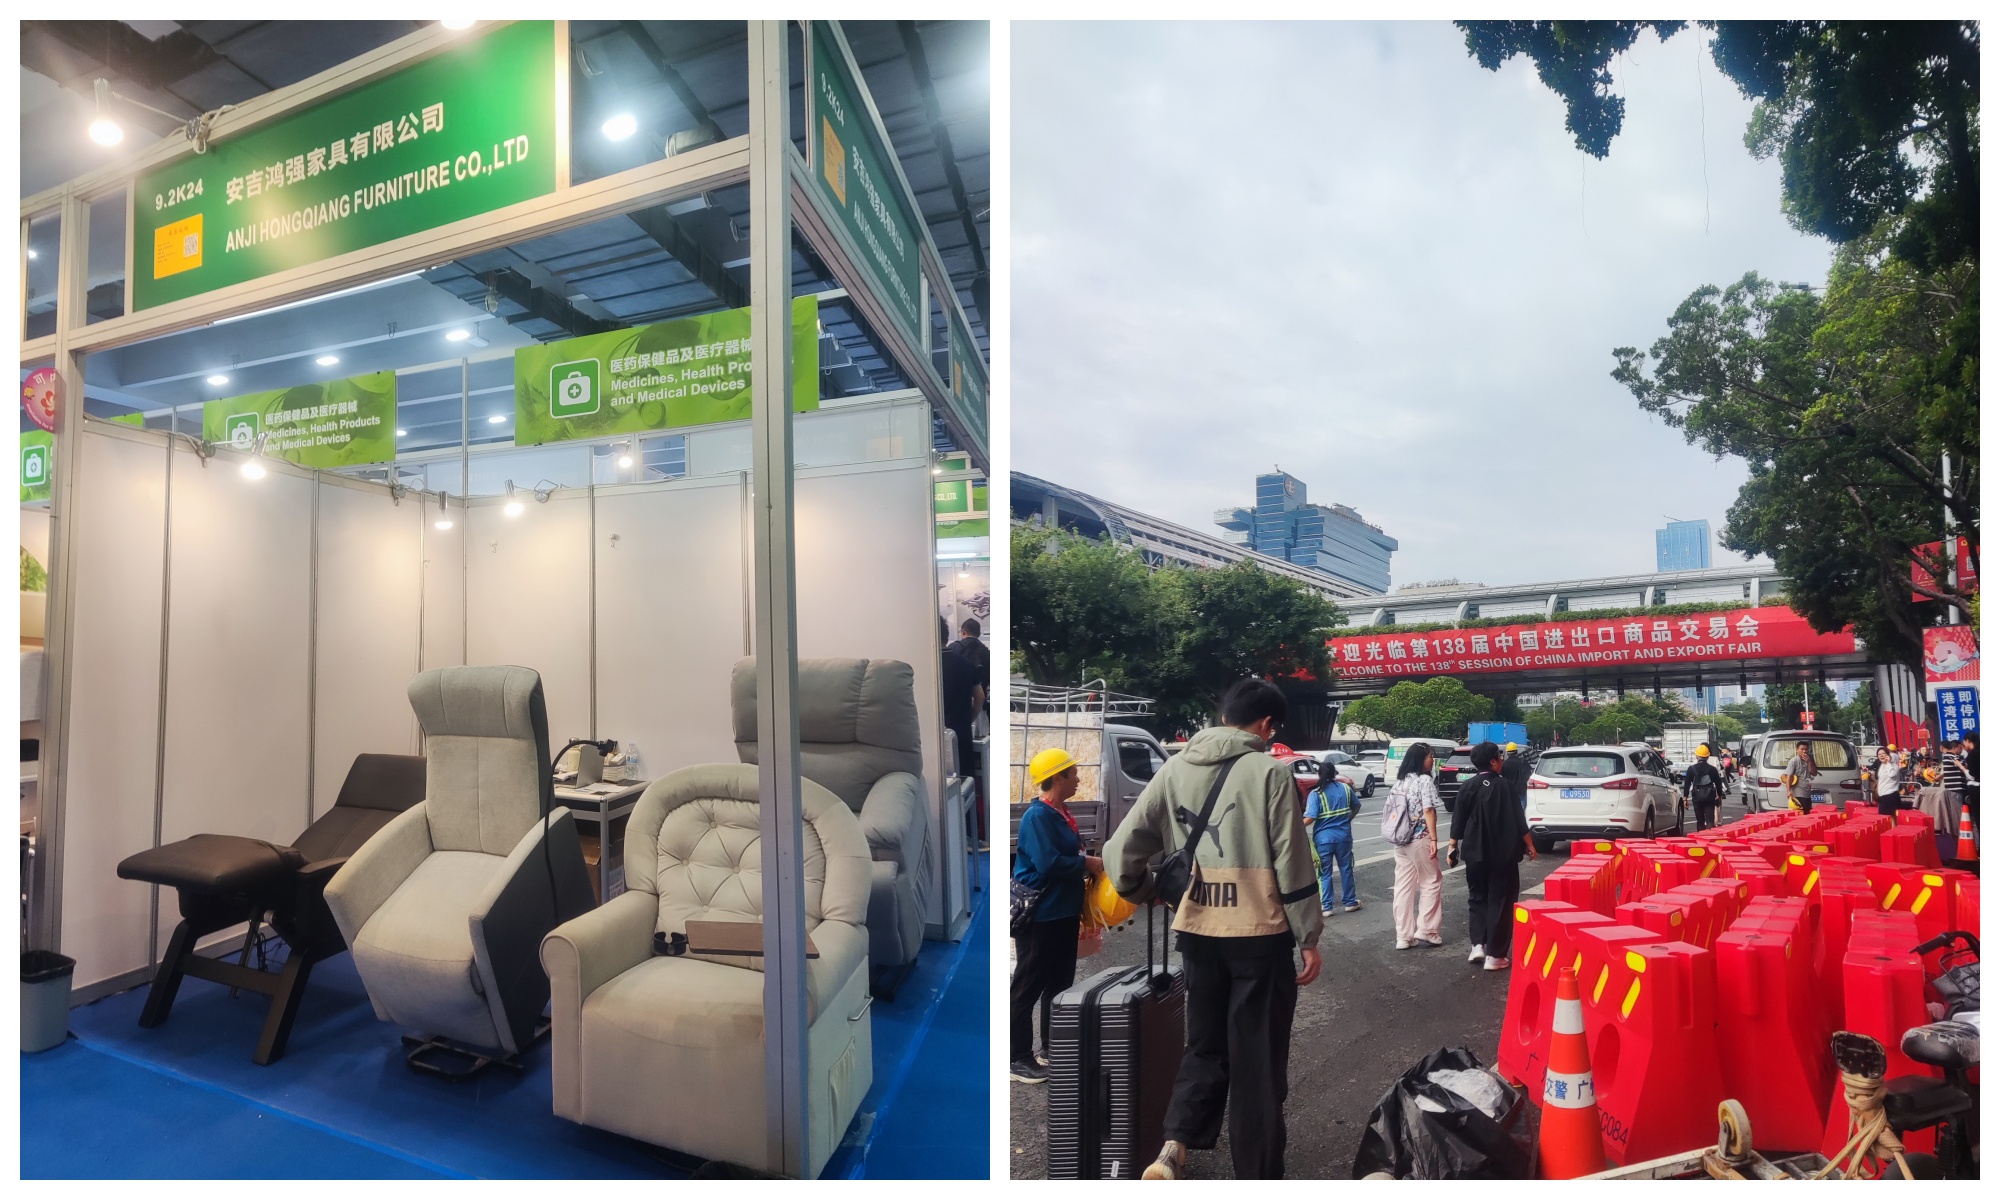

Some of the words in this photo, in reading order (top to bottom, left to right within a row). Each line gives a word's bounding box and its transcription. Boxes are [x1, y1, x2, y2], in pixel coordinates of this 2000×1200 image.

[821, 72, 844, 127] 9.2K24
[226, 102, 443, 205] 安吉鸿强家具有限公司
[155, 178, 204, 211] 9.2K24
[225, 225, 257, 253] ANJI
[260, 194, 350, 243] HONGQIANG
[354, 160, 450, 214] FURNITURE
[454, 134, 529, 181] CO.,LTD
[610, 337, 752, 374] 医药保健品及医疗器械
[610, 394, 634, 407] and
[637, 385, 687, 404] Medical
[690, 379, 746, 396] Devices
[611, 372, 679, 392] Medicines,
[681, 361, 724, 381] Health
[728, 361, 752, 375] Pro
[265, 400, 358, 425] 医药保健品及医疗器械
[265, 425, 309, 440] Medicines,
[311, 420, 338, 434] Health
[340, 415, 381, 430] Products
[265, 441, 281, 452] and
[282, 437, 314, 450] Medical
[316, 433, 351, 446] Devices
[1385, 663, 1402, 674] TO
[1404, 662, 1428, 673] THE
[1458, 657, 1513, 670] SESSION
[1515, 655, 1532, 667] OF
[1534, 652, 1576, 665] CHINA
[1578, 649, 1630, 663] IMPORT
[1633, 647, 1664, 660] AND
[1667, 643, 1725, 657] EXPORT
[1728, 641, 1762, 654] FAIR
[1941, 691, 1961, 742] 港湾区域
[1958, 690, 1976, 731] 即停即
[1188, 882, 1238, 907] UMA
[1597, 1105, 1629, 1147] C084
